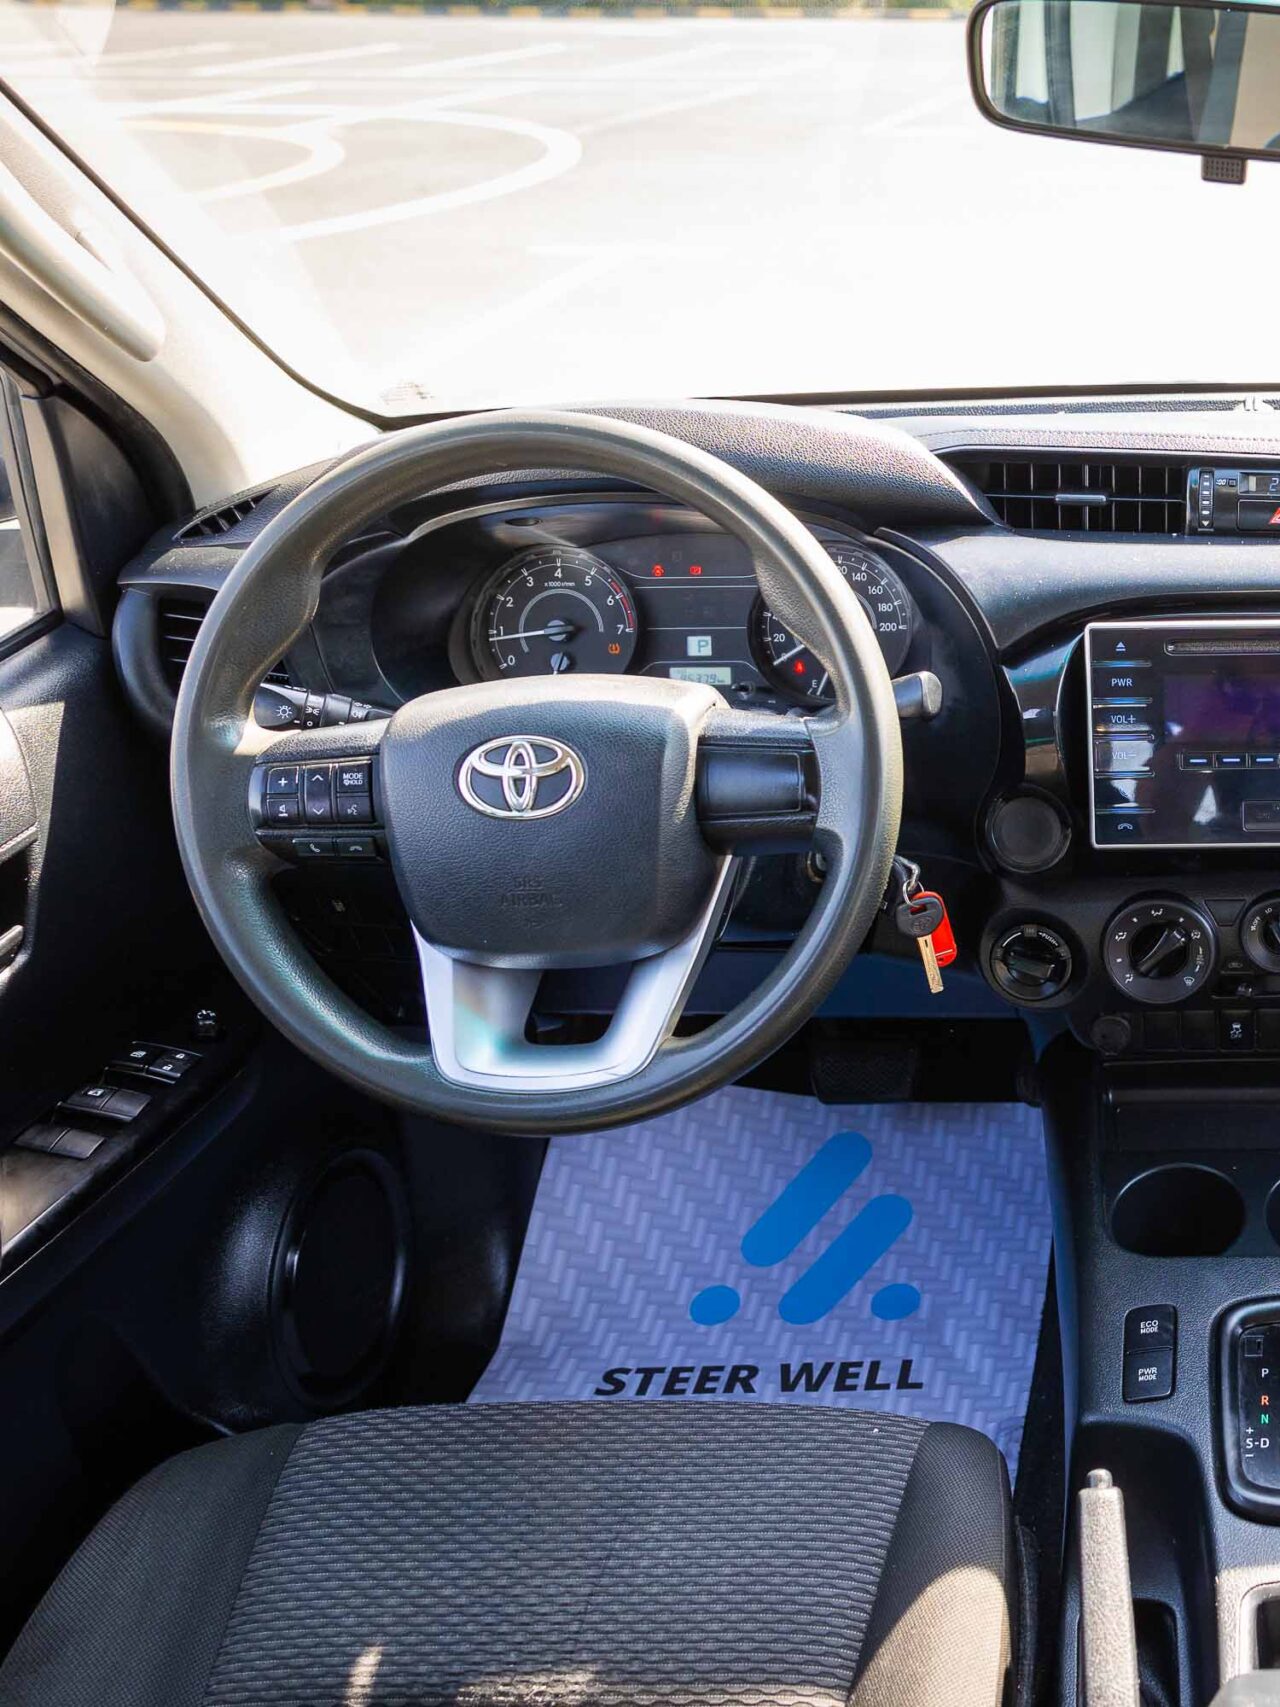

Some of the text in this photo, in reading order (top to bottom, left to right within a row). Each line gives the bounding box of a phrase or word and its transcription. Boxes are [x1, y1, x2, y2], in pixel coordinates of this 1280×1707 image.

[554, 568, 562, 578] 4
[852, 572, 867, 581] 140
[526, 577, 534, 587] 3
[584, 576, 592, 586] 5
[868, 586, 883, 595] 160
[506, 598, 514, 607] 2
[606, 596, 615, 606] 6
[878, 603, 893, 612] 180
[616, 624, 624, 634] 7
[879, 622, 897, 632] 200
[773, 633, 785, 643] 20
[698, 641, 709, 653] P
[507, 655, 515, 666] 0
[812, 679, 818, 688] E
[1111, 678, 1133, 687] PWR
[1140, 1320, 1159, 1328] ECO
[1140, 1326, 1159, 1334] MODE
[1138, 1367, 1158, 1375] PWR
[1261, 1368, 1269, 1378] P
[594, 1359, 924, 1396] STEER WELL
[1138, 1374, 1157, 1382] MODE
[1260, 1395, 1270, 1406] R
[1260, 1414, 1269, 1424] N
